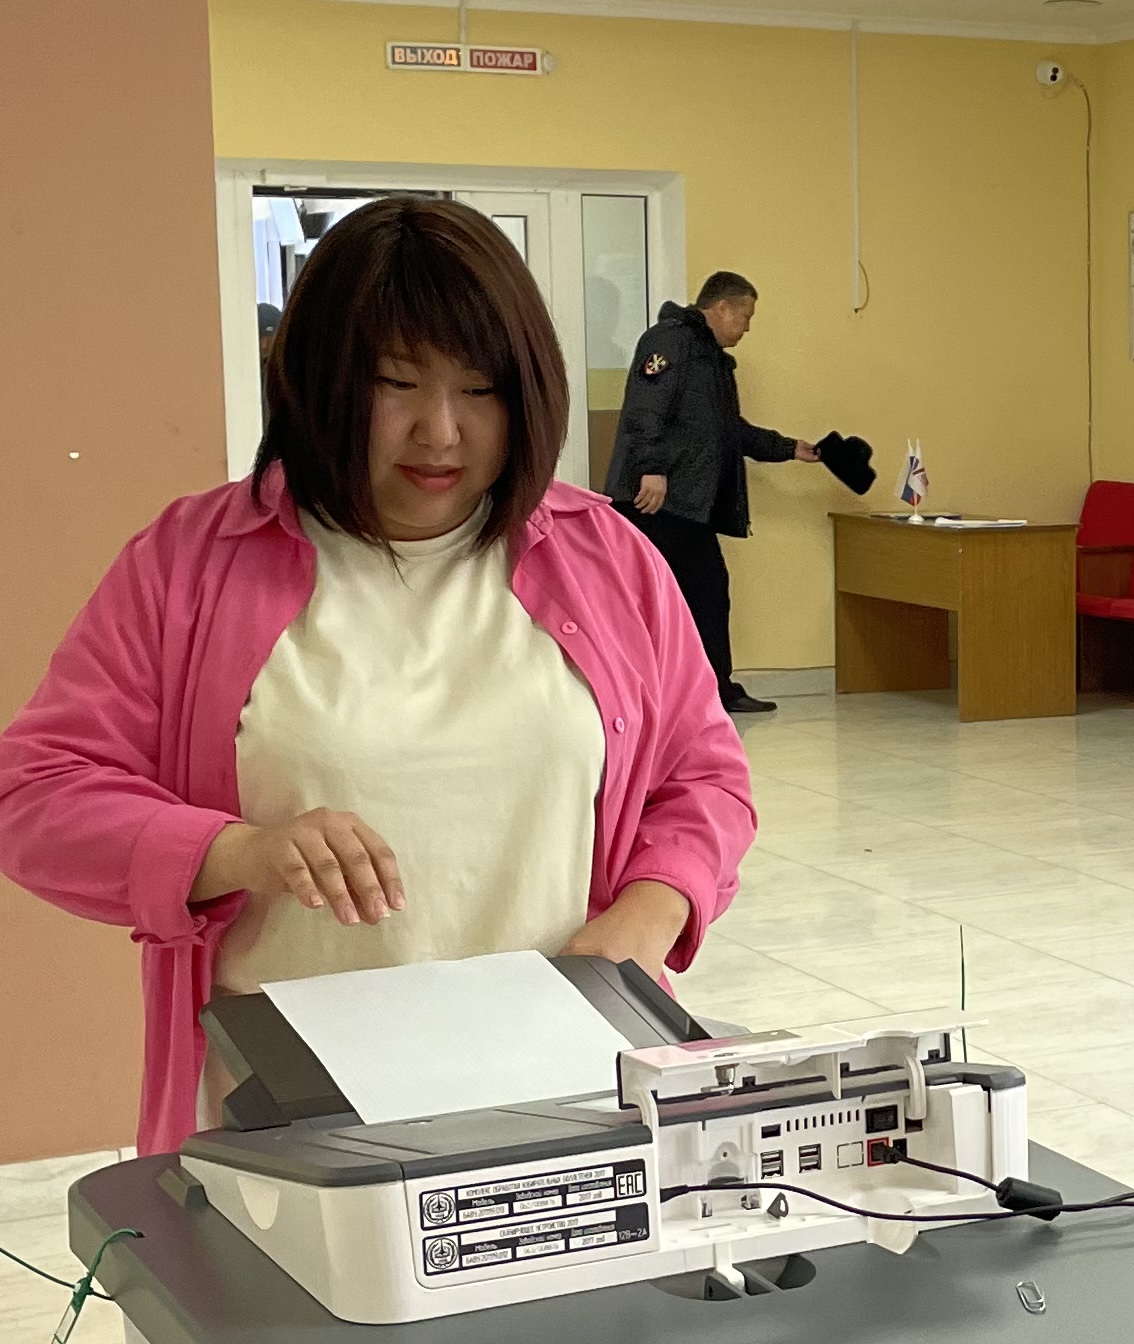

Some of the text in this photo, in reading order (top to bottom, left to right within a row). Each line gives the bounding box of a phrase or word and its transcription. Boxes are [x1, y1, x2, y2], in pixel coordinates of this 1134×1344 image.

[394, 47, 534, 69] ВЫХОД ПОЖАР
[618, 1173, 642, 1195] EAC
